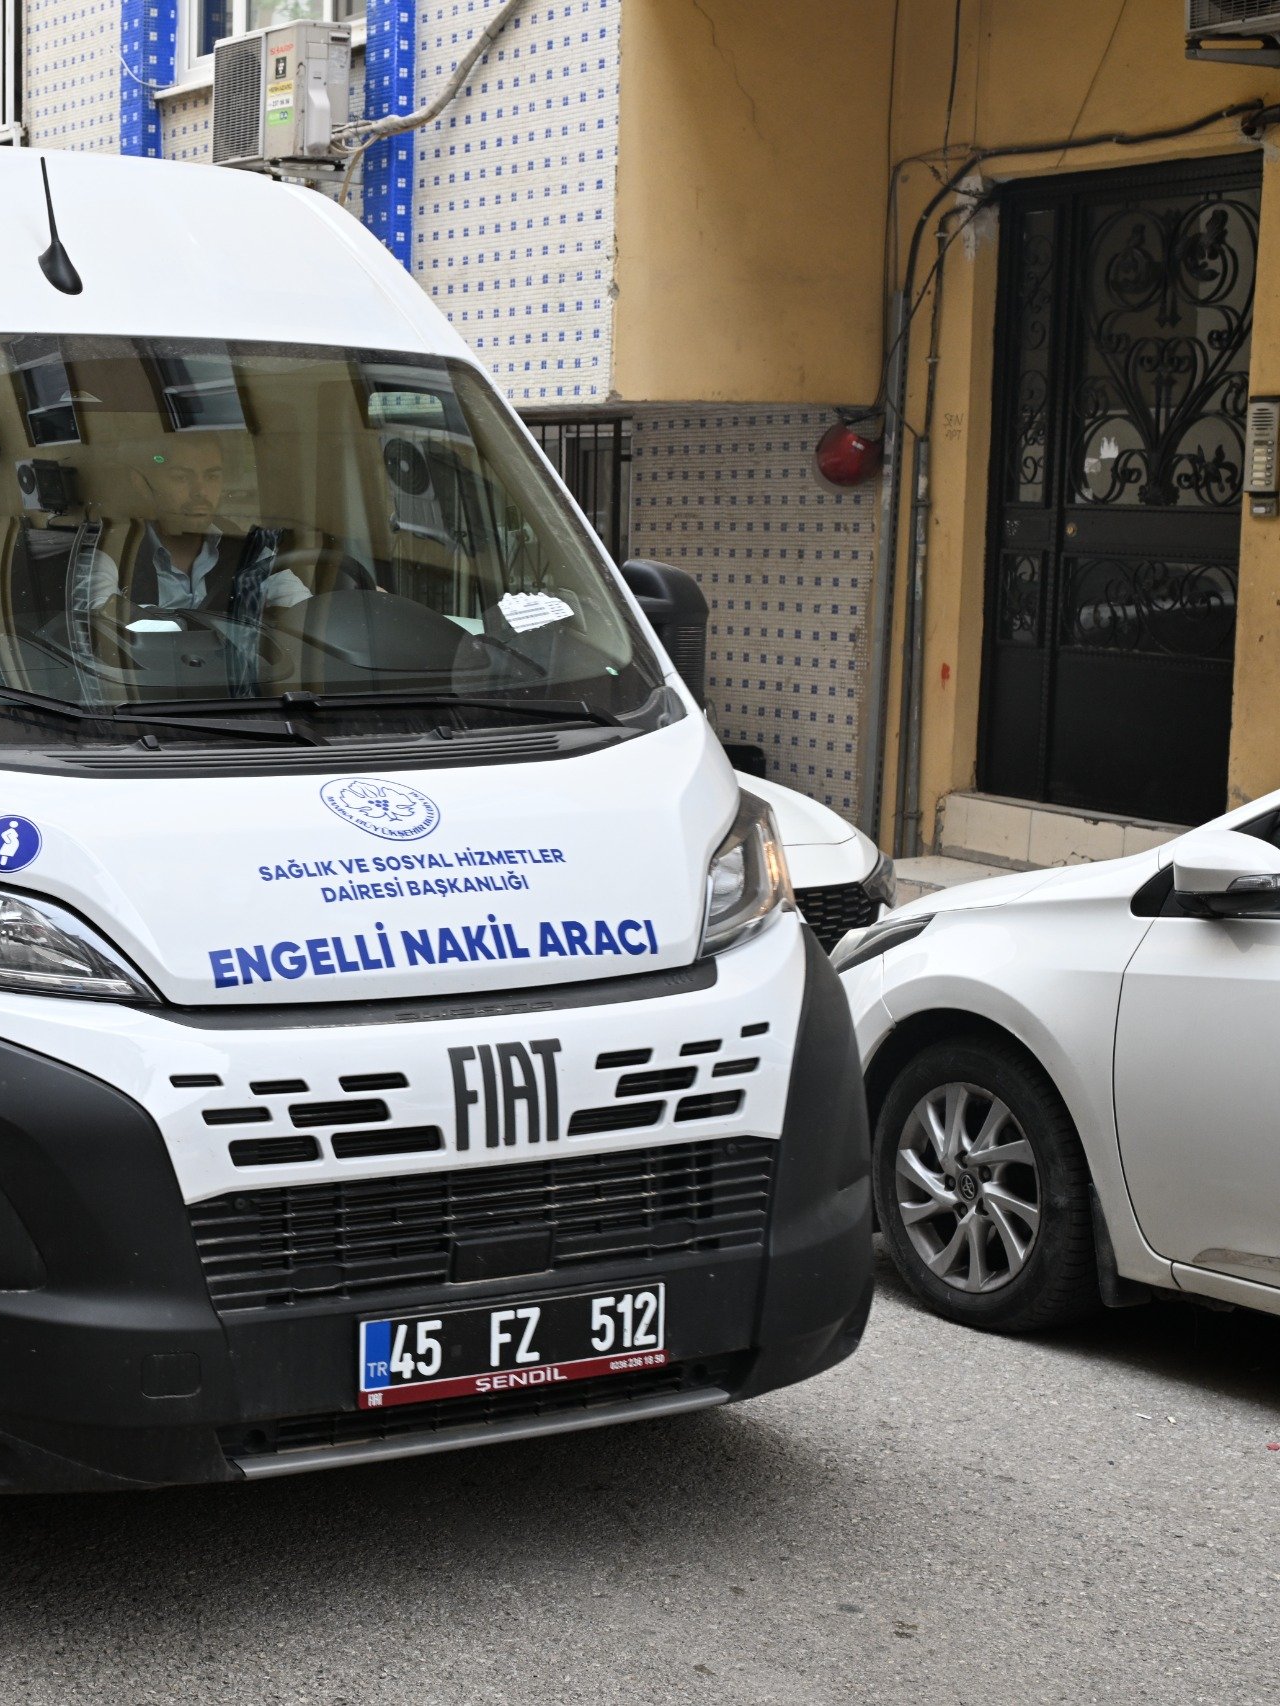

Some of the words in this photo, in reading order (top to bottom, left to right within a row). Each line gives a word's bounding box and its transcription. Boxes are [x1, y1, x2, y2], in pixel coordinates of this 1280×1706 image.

[258, 859, 338, 882] SAĞLIK
[337, 858, 369, 875] VE
[372, 853, 453, 871] SOSYAL
[455, 847, 567, 867] HİZMETLER
[320, 877, 403, 903] DAİRESİ
[407, 870, 530, 898] BAŞKANLIĞI
[209, 921, 396, 989] ENGELLİ
[400, 913, 530, 966] NAKİL
[539, 919, 659, 957] ARACI
[447, 1038, 562, 1151] FIAT
[367, 1361, 388, 1378] TR
[390, 1319, 442, 1379] 45
[490, 1307, 541, 1366] FZ
[591, 1291, 657, 1351] 512
[475, 1366, 568, 1392] ŞENDİL
[628, 1357, 644, 1368] 236
[367, 1393, 383, 1407] FIAT
